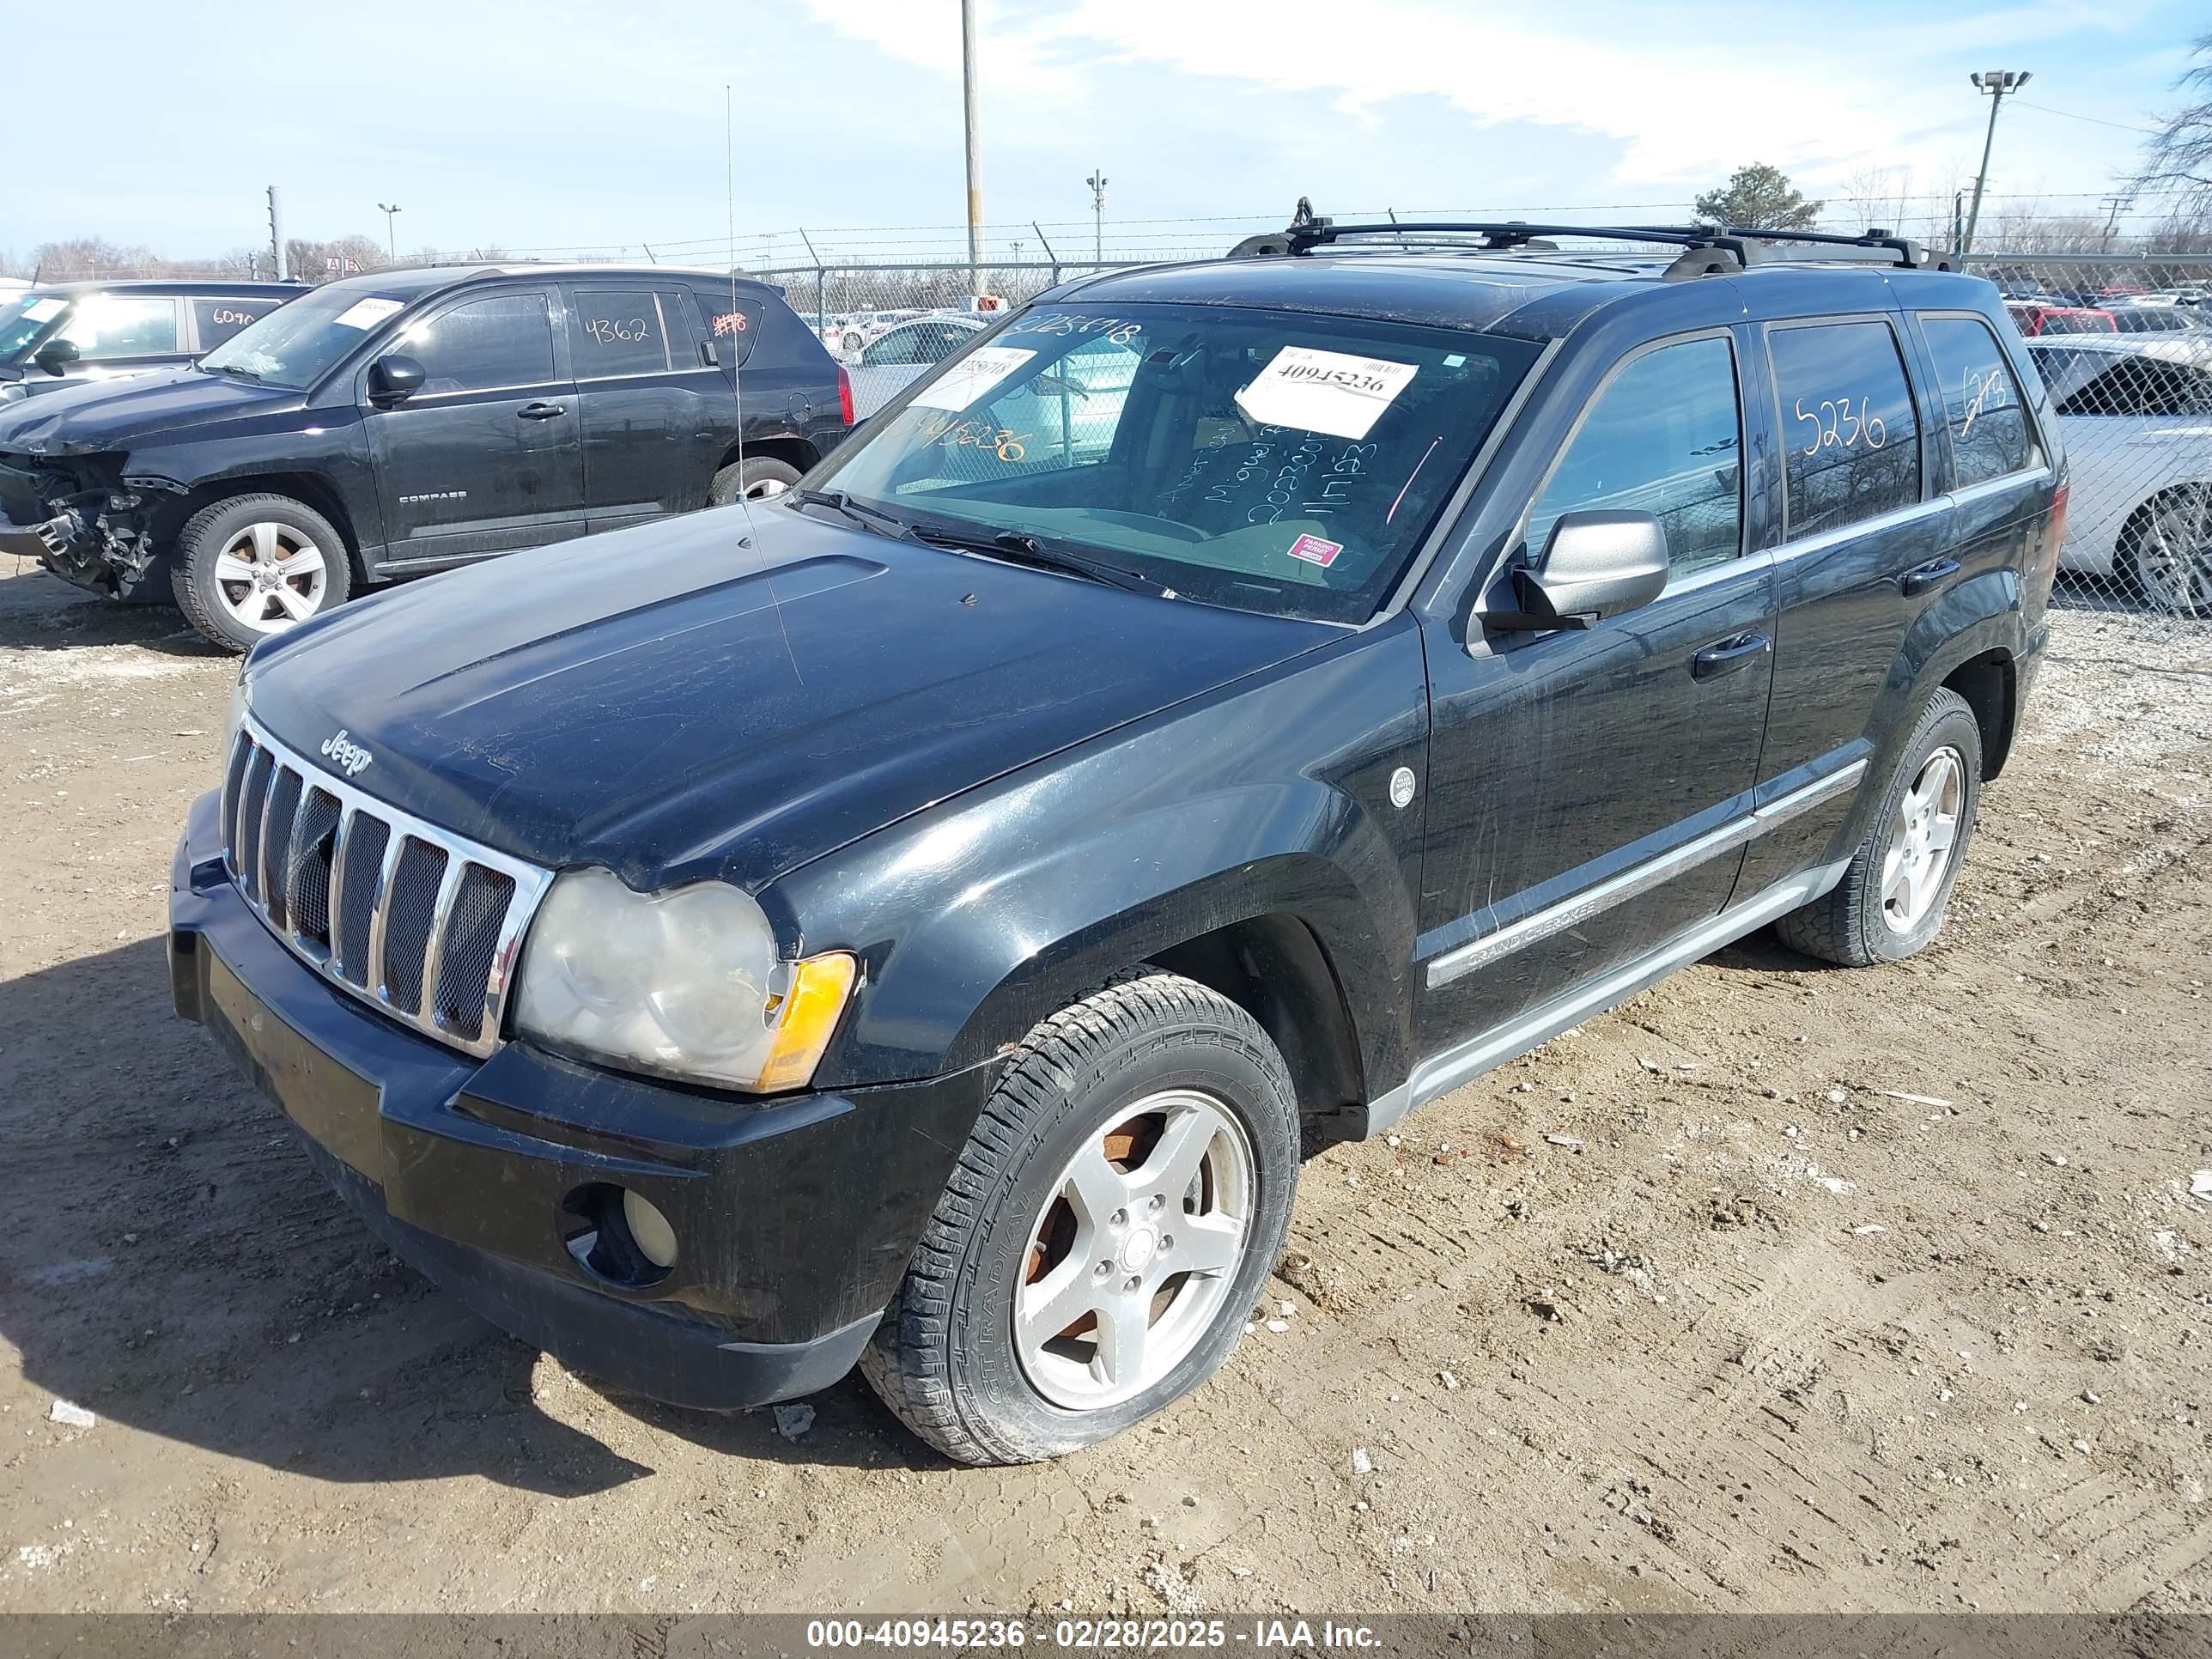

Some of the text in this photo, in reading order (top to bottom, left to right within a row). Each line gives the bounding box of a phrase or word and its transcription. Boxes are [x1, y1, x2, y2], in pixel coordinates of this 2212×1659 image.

[329, 258, 338, 270] A
[347, 259, 357, 270] B
[585, 318, 650, 346] 4362
[1278, 363, 1389, 392] 40945236
[1796, 395, 1887, 456] 5236
[398, 490, 468, 503] COMPASS
[1304, 538, 1334, 551] PARKING
[1304, 544, 1329, 555] PERMIT
[320, 729, 372, 776] Jeep
[1469, 901, 1595, 966] GRAND CHEROKEE
